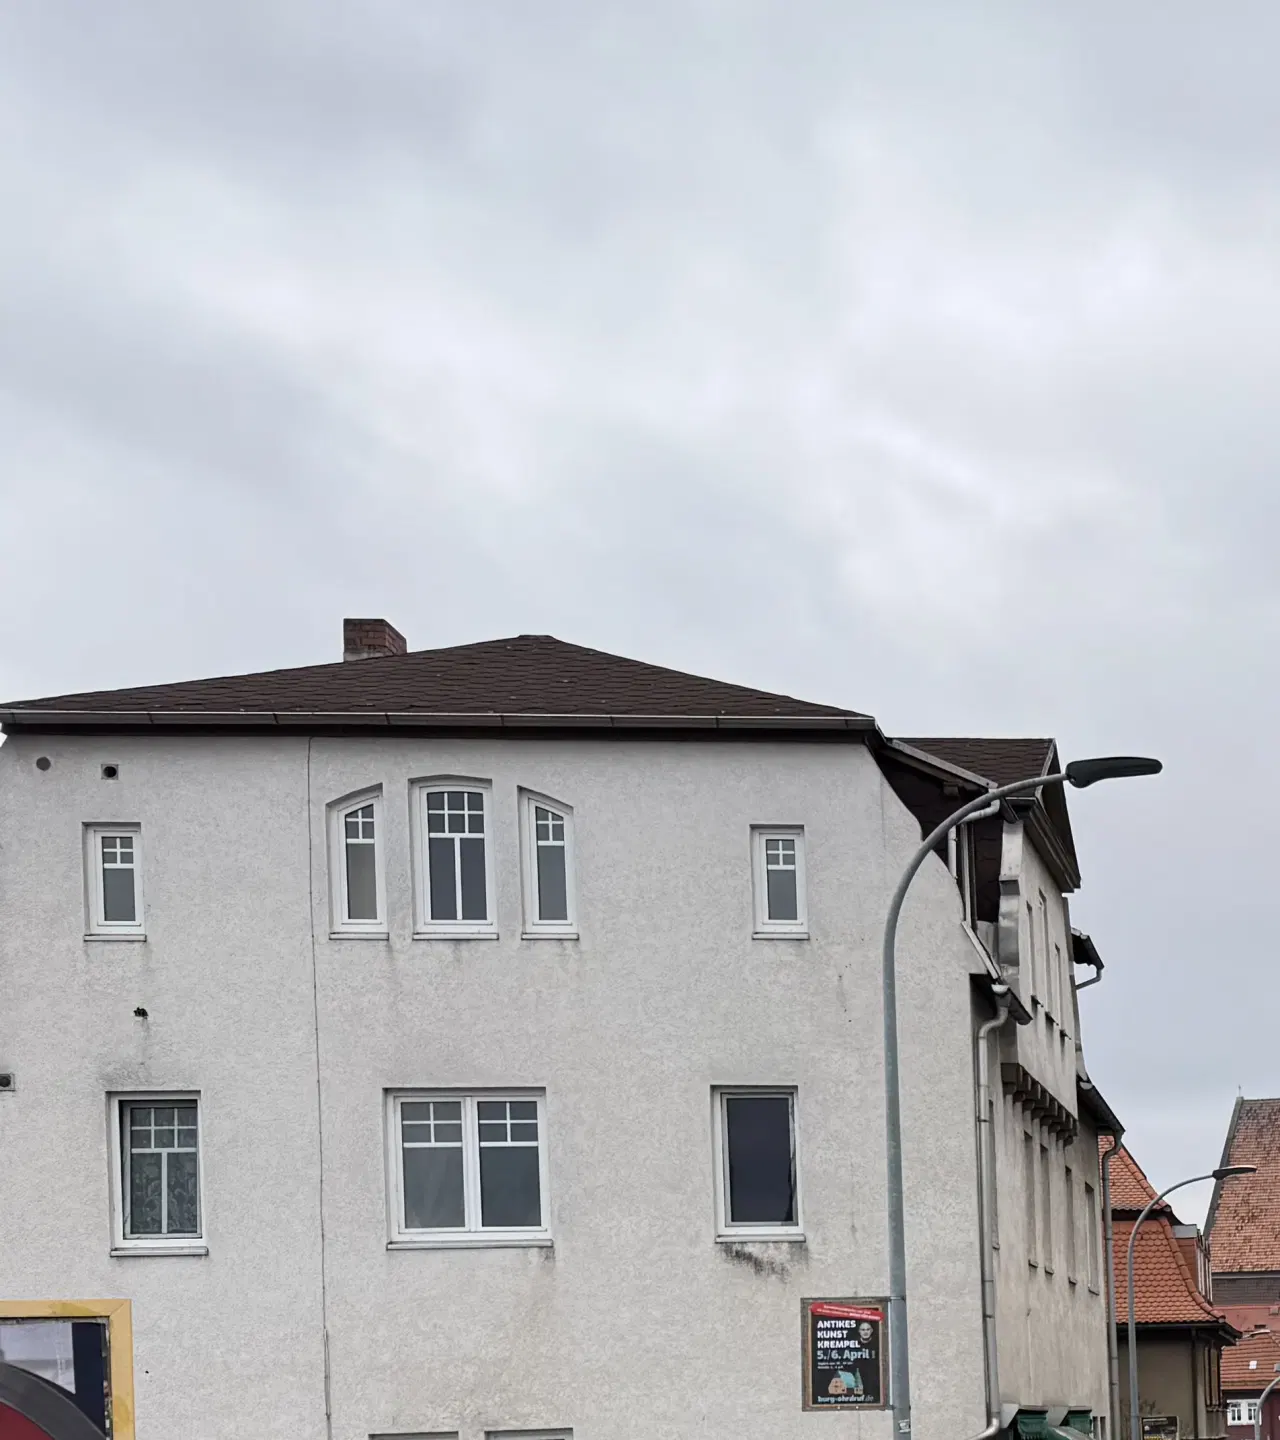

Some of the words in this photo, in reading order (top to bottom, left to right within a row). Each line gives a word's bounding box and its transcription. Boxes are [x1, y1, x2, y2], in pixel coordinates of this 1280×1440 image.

[817, 1320, 856, 1328] ANTIKES
[817, 1330, 848, 1338] KUNST
[817, 1340, 860, 1348] KREMPEL
[817, 1349, 841, 1360] 5./6.
[843, 1348, 870, 1361] April
